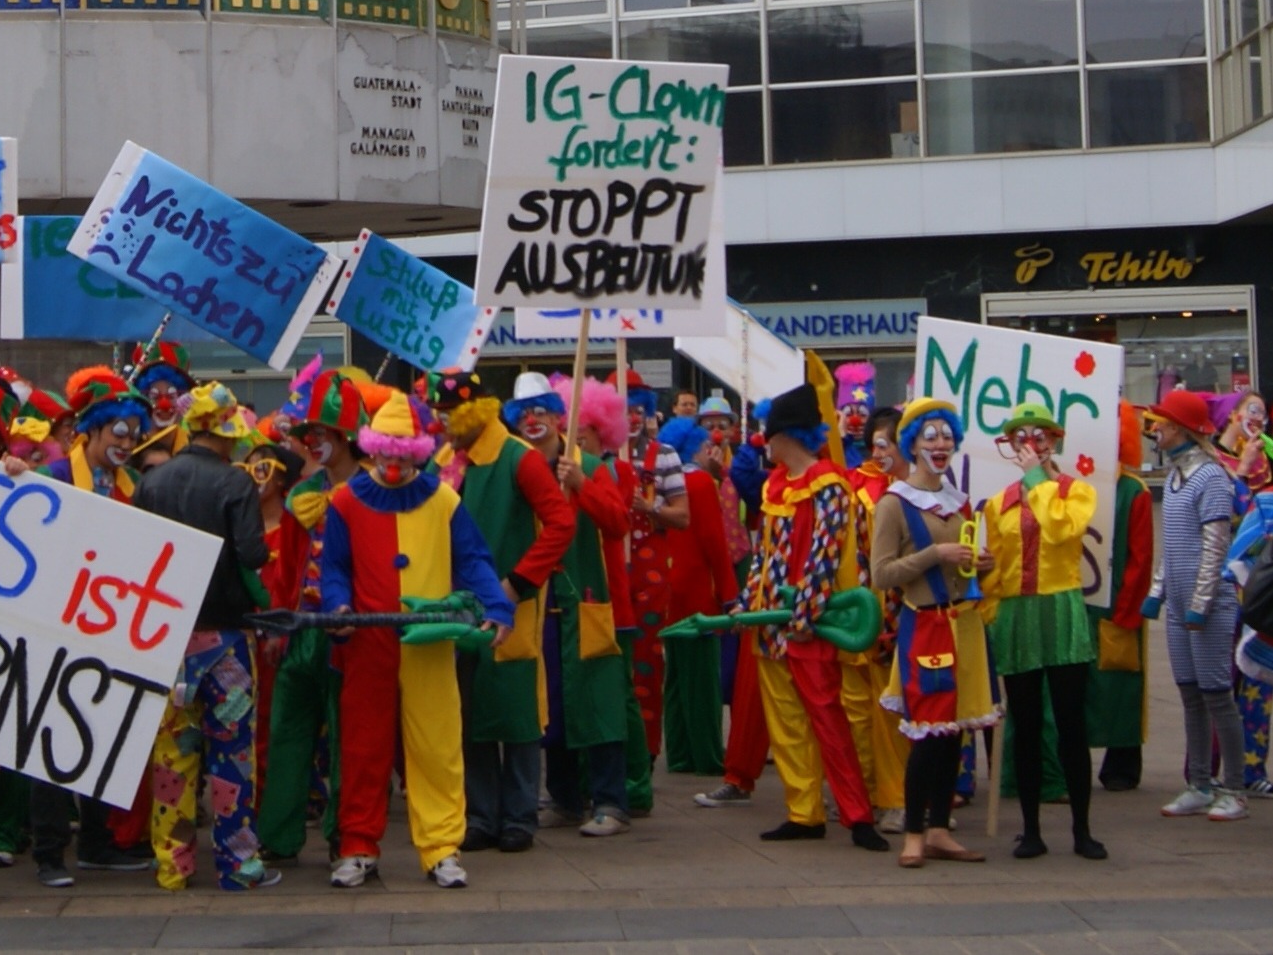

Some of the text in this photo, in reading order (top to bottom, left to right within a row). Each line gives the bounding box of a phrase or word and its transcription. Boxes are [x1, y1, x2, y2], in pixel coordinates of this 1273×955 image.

[391, 95, 422, 110] STADT
[350, 140, 410, 157] GALÁPAGOS
[361, 126, 415, 141] MANAGUA
[507, 178, 706, 243] STOPPT
[126, 234, 266, 347] Lachen
[1080, 249, 1204, 283] Tchibo
[923, 335, 1100, 455] Mehr
[61, 541, 184, 651] ist
